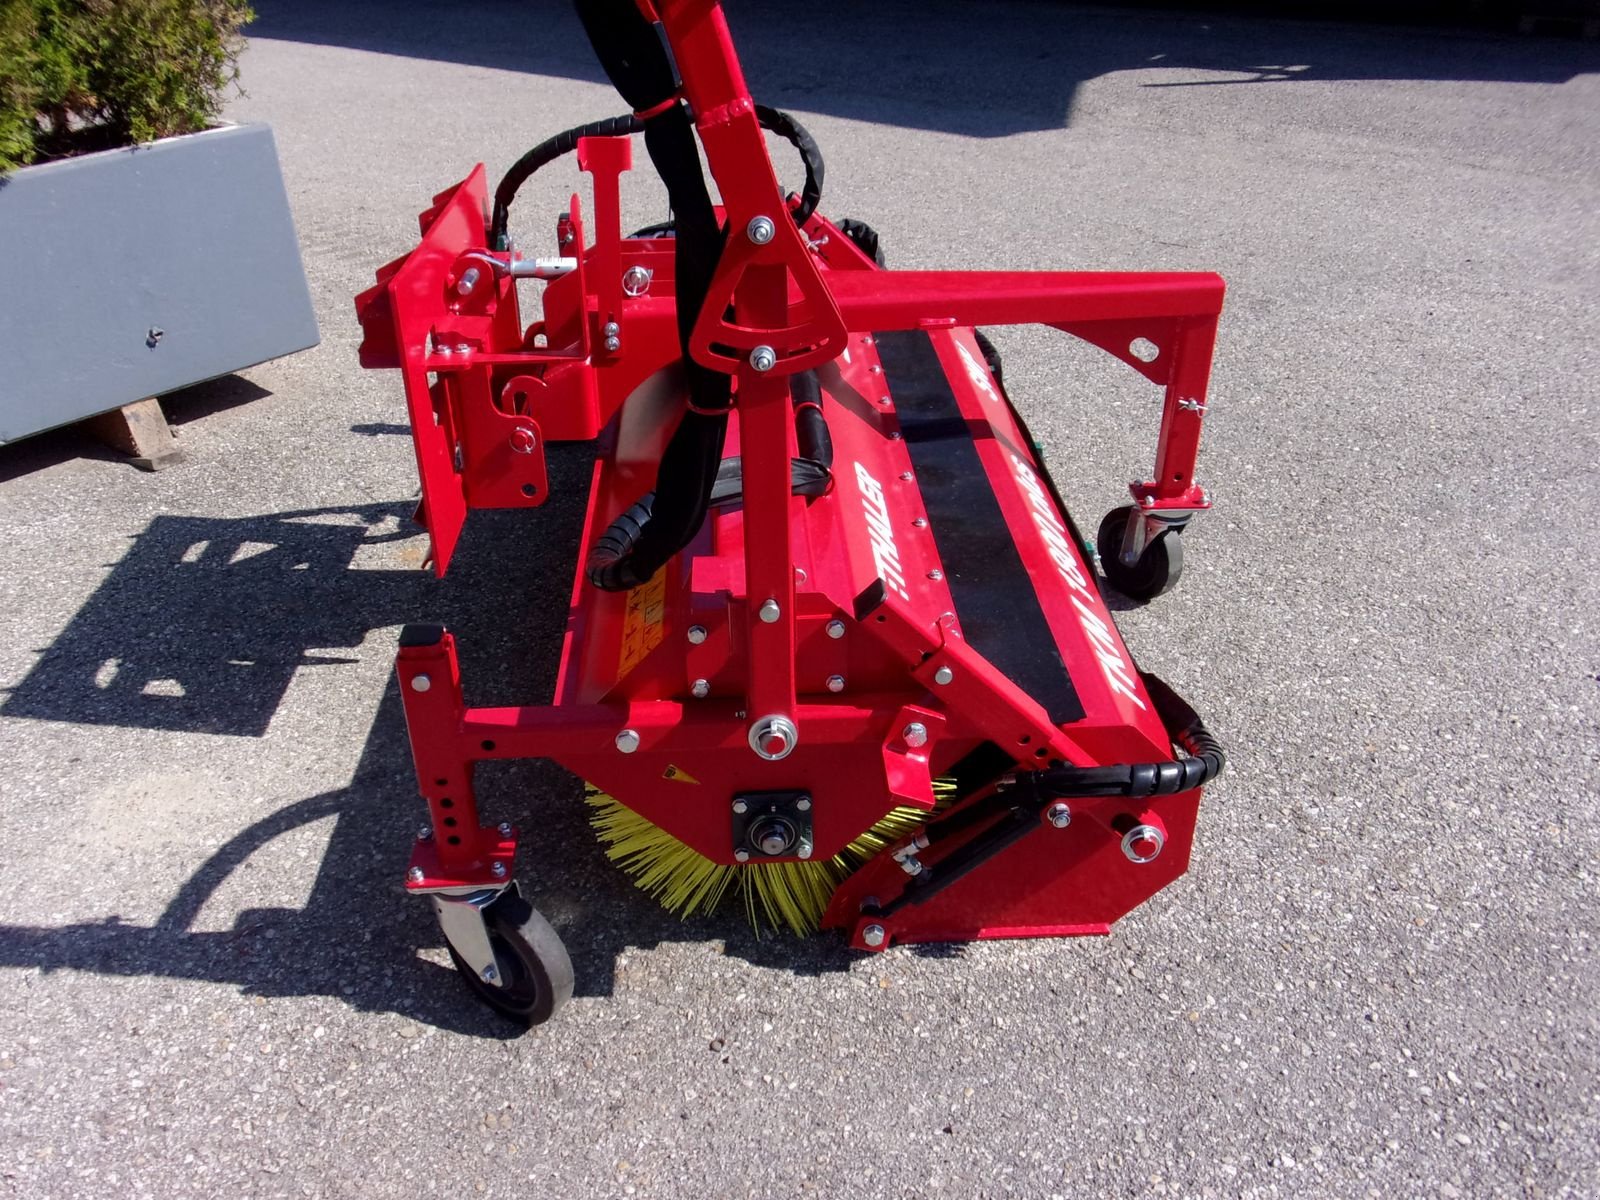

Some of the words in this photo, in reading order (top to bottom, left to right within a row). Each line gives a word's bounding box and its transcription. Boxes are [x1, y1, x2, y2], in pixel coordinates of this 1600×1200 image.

[854, 461, 908, 599] THALER
[1010, 454, 1065, 533] plus
[1033, 511, 1094, 603] 1800
[1072, 594, 1147, 711] TKM
